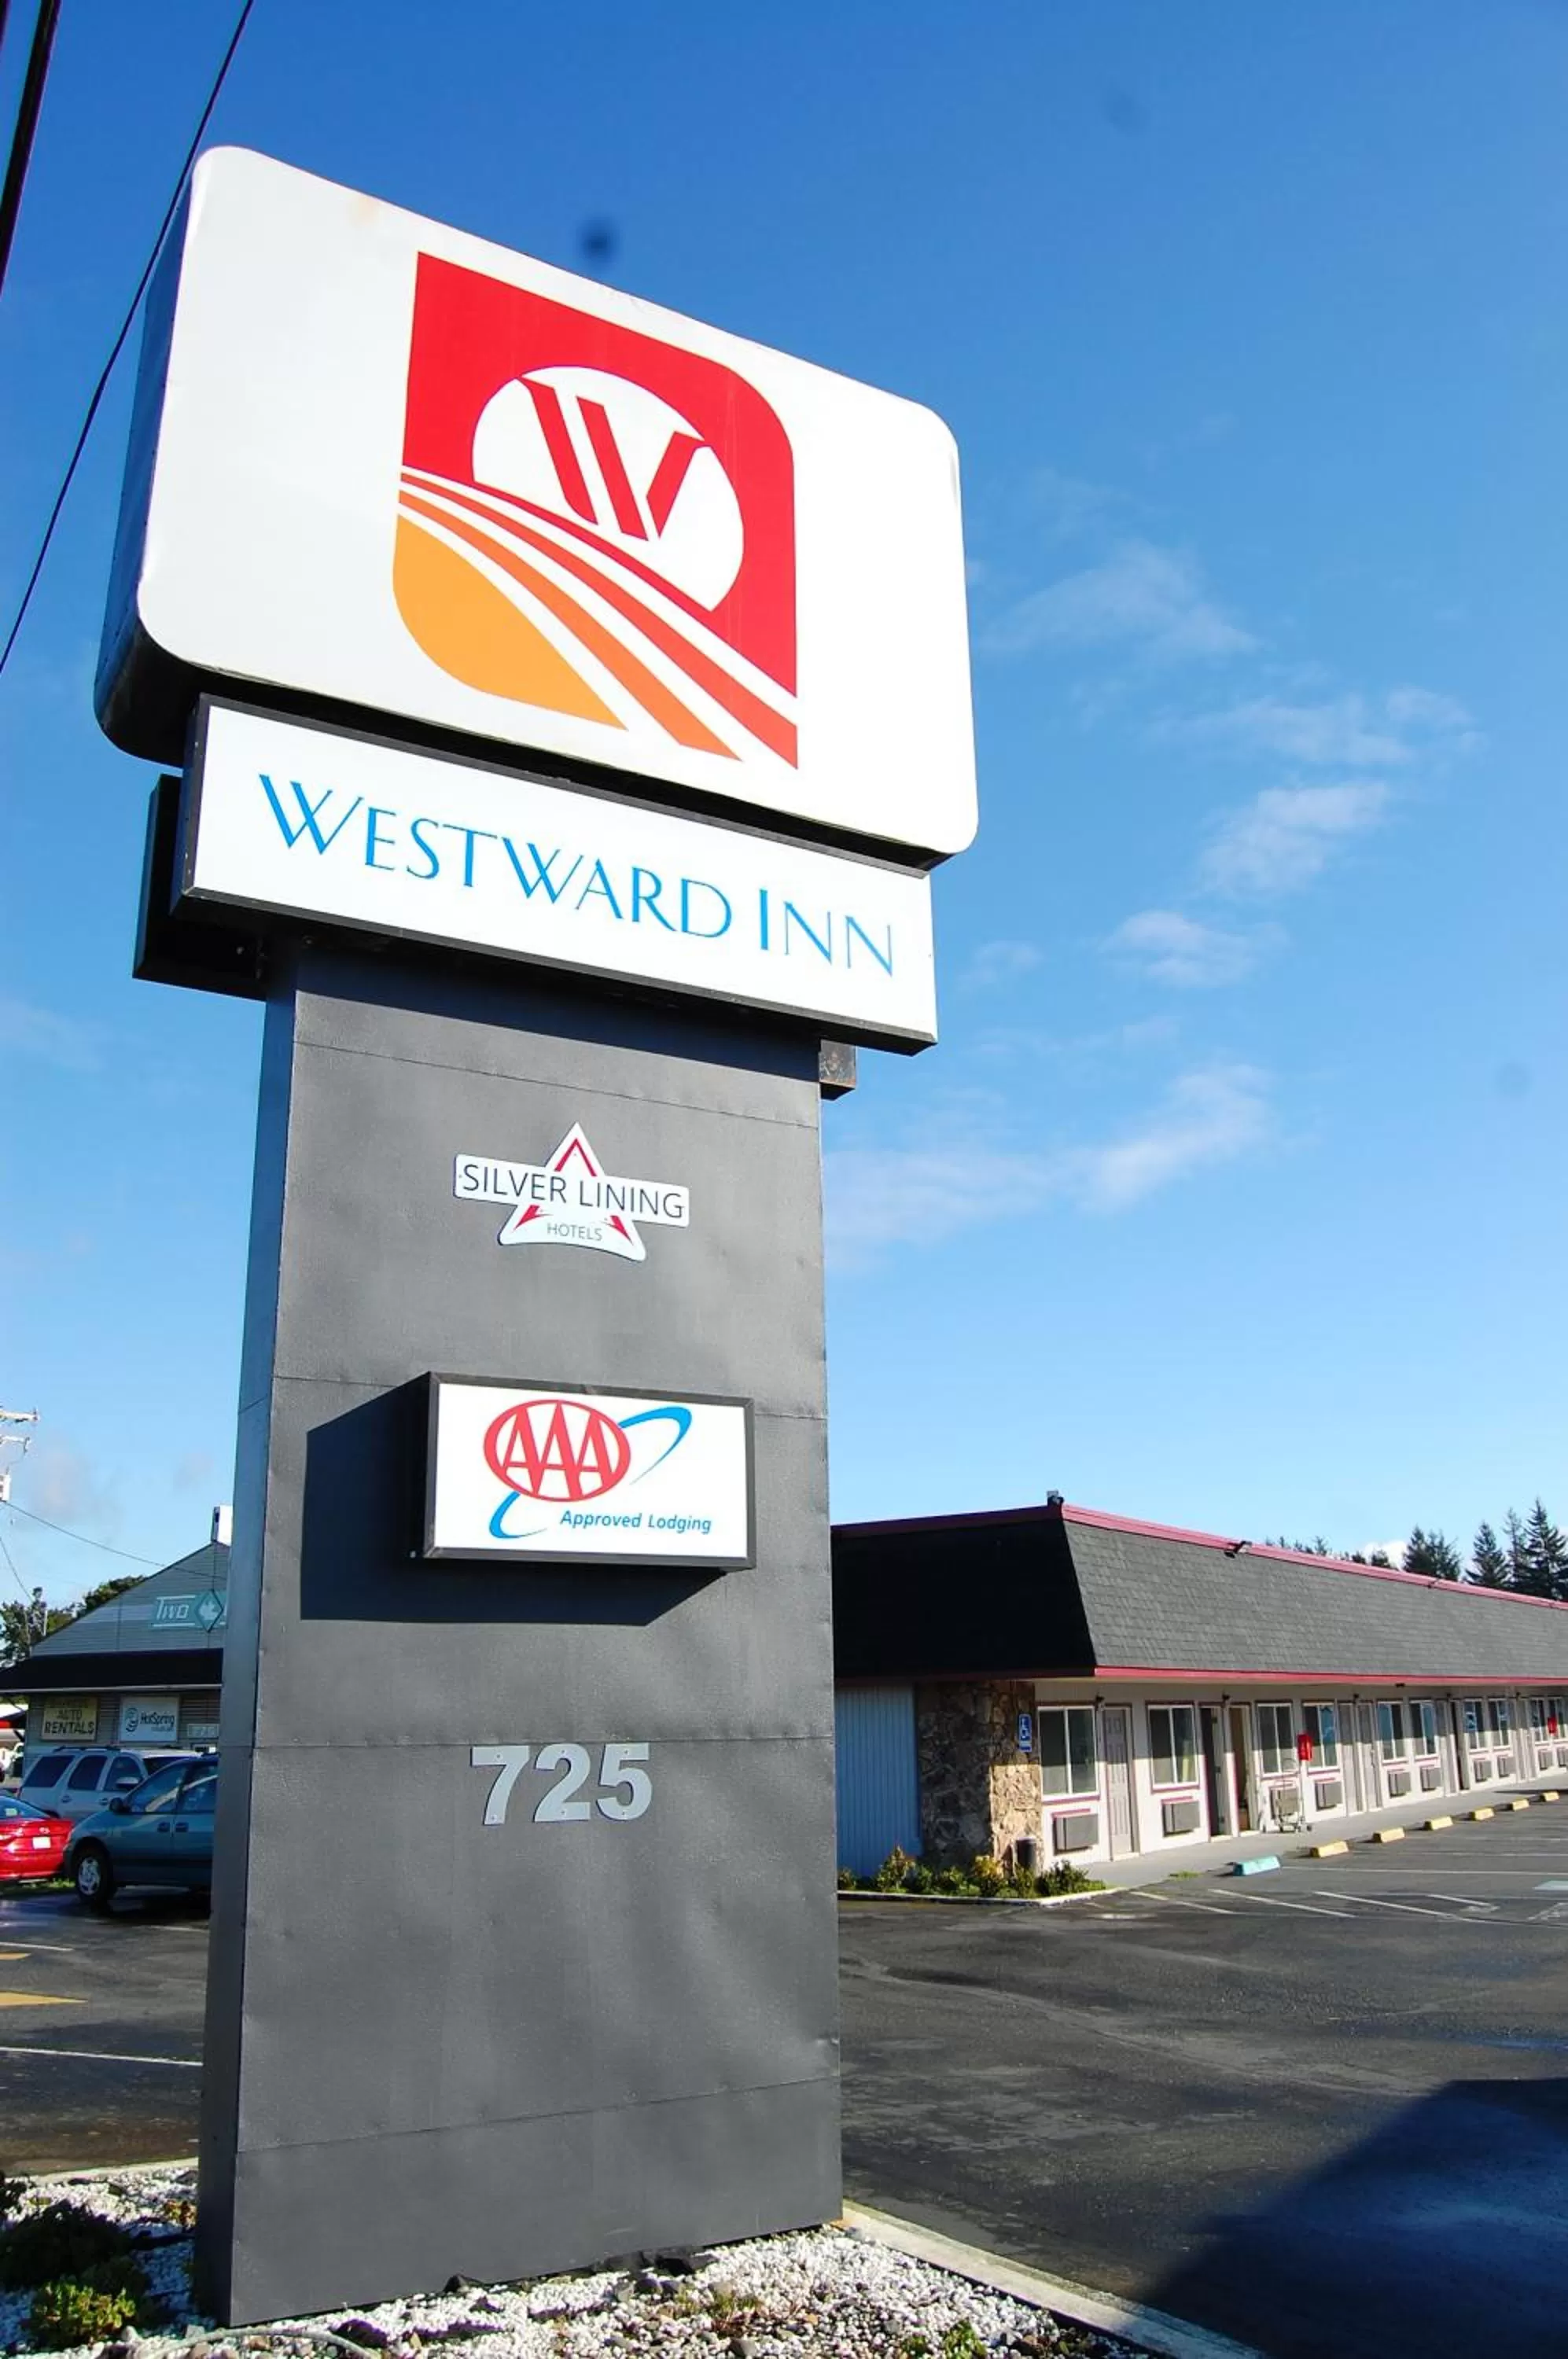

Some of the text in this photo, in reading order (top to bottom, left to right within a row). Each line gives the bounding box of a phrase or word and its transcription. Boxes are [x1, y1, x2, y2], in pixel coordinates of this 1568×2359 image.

[258, 773, 894, 976] WESTWARD INN
[462, 1164, 686, 1219] SILVER LINING
[547, 1222, 603, 1242] HOTELS
[489, 1399, 626, 1500] AAA
[559, 1509, 712, 1535] Approved Lodging
[44, 1720, 95, 1735] RENTALS
[469, 1742, 653, 1826] 725
